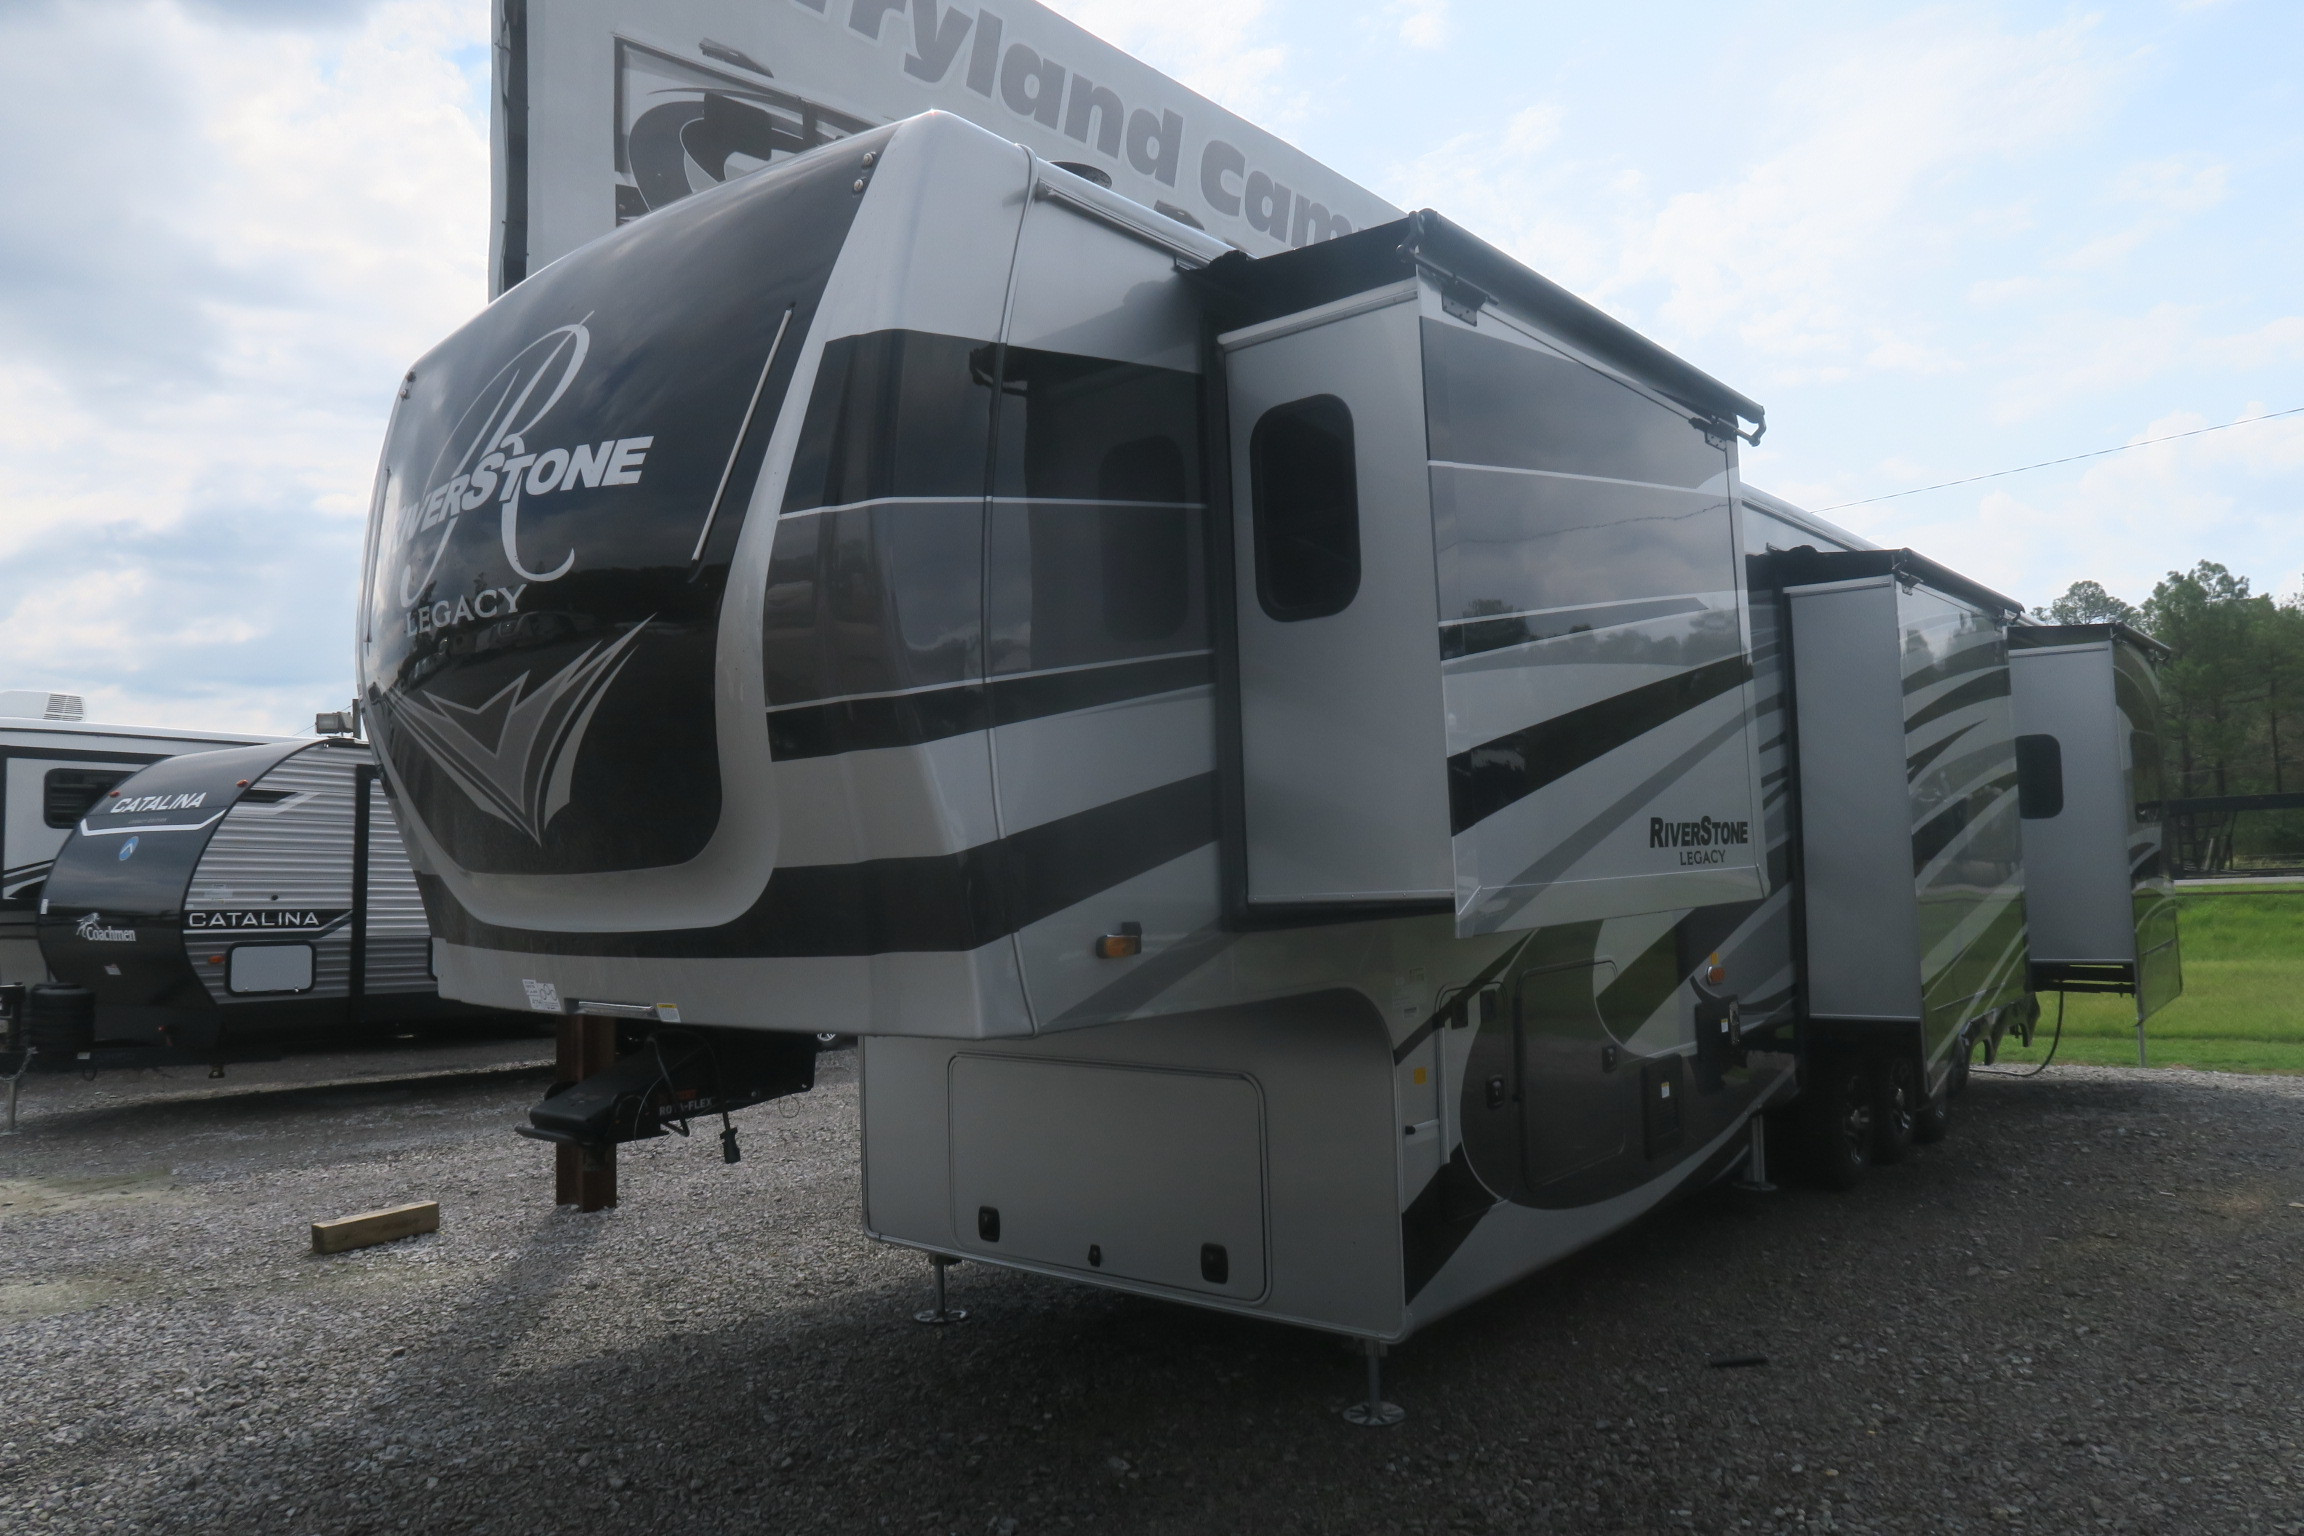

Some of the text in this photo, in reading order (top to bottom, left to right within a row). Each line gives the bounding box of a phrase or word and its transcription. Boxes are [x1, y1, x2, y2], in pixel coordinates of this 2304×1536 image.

[796, 0, 1368, 247] ryland Cam
[406, 585, 526, 637] LEGACY
[111, 793, 207, 814] CATALINA
[1680, 850, 1726, 866] LEGACY
[189, 912, 320, 928] CATALINA
[87, 926, 136, 942] Coachmen
